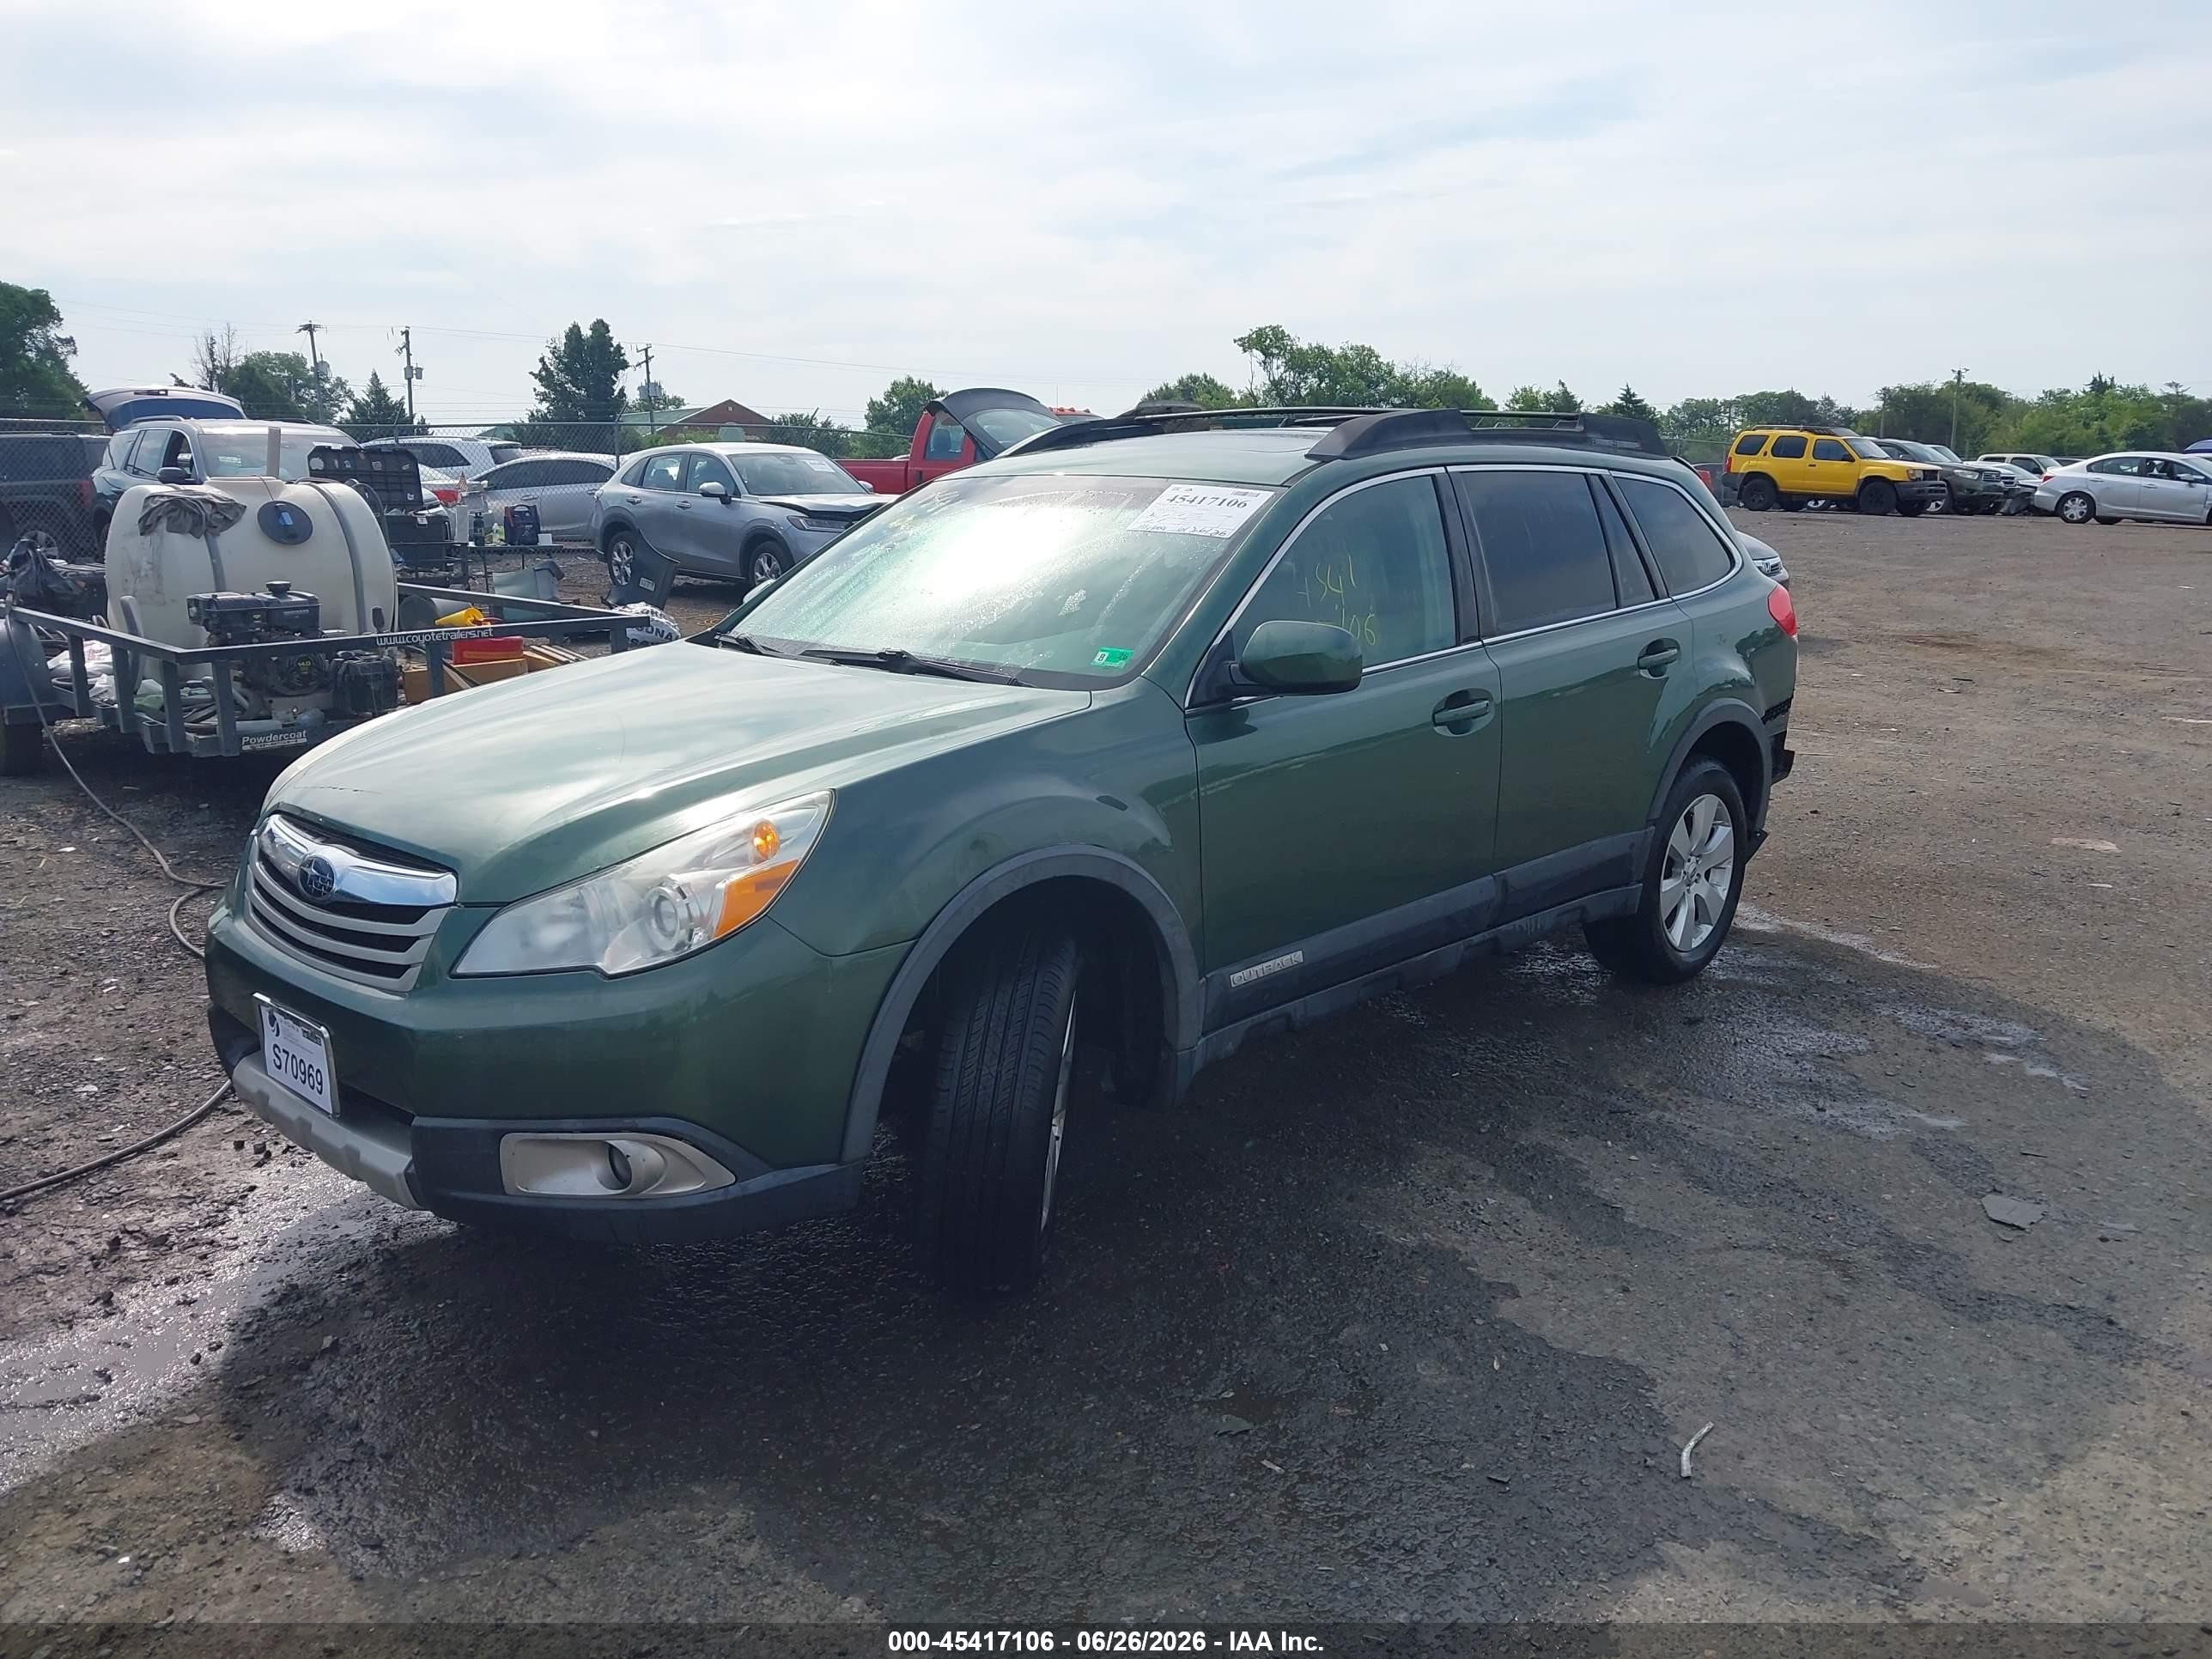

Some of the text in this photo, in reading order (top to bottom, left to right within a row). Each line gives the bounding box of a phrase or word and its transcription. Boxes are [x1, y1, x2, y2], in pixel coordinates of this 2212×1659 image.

[1166, 495, 1248, 509] 45417106
[376, 628, 494, 646] www.coyotetrailers.net
[241, 730, 307, 745] Powdercoat
[1231, 951, 1303, 987] OUTBACK
[272, 1042, 324, 1096] S70969
